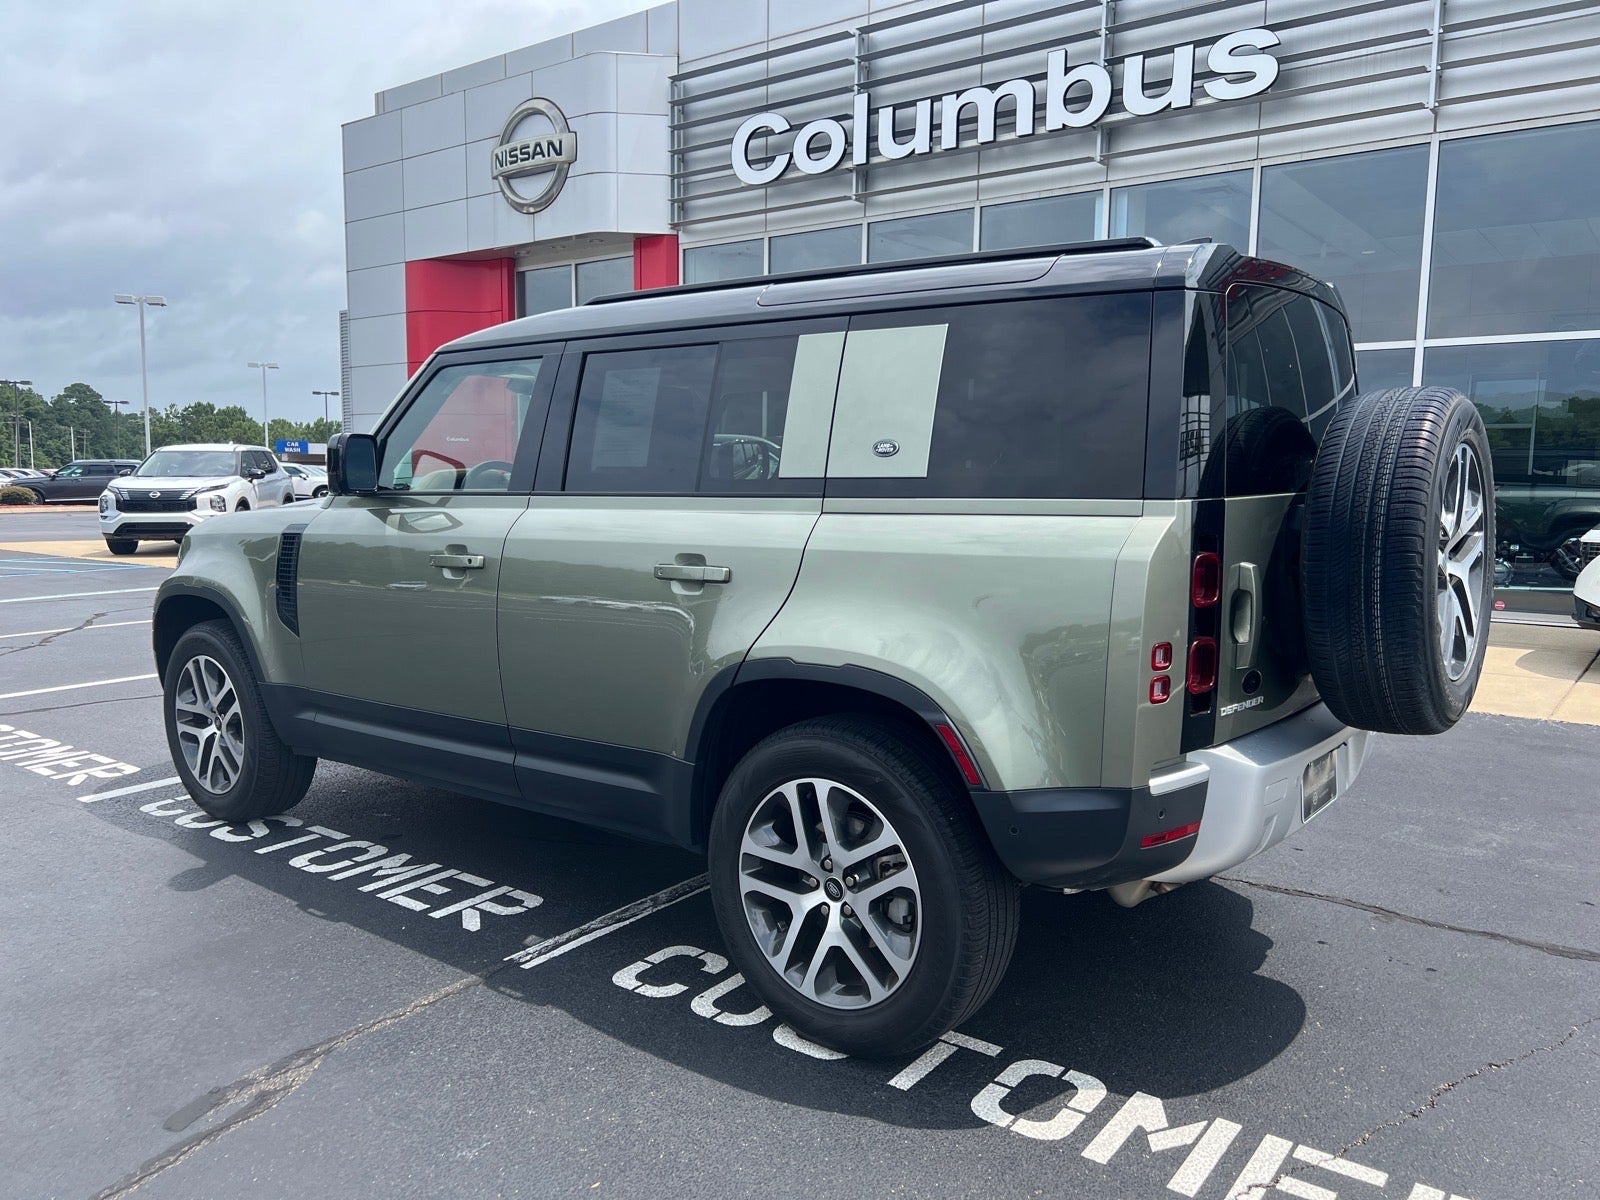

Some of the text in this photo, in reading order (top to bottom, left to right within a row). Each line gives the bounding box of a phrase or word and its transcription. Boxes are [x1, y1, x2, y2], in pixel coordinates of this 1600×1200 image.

[731, 28, 1281, 185] Columbus
[494, 139, 563, 170] NISSAN
[1220, 696, 1264, 717] DEFENDER
